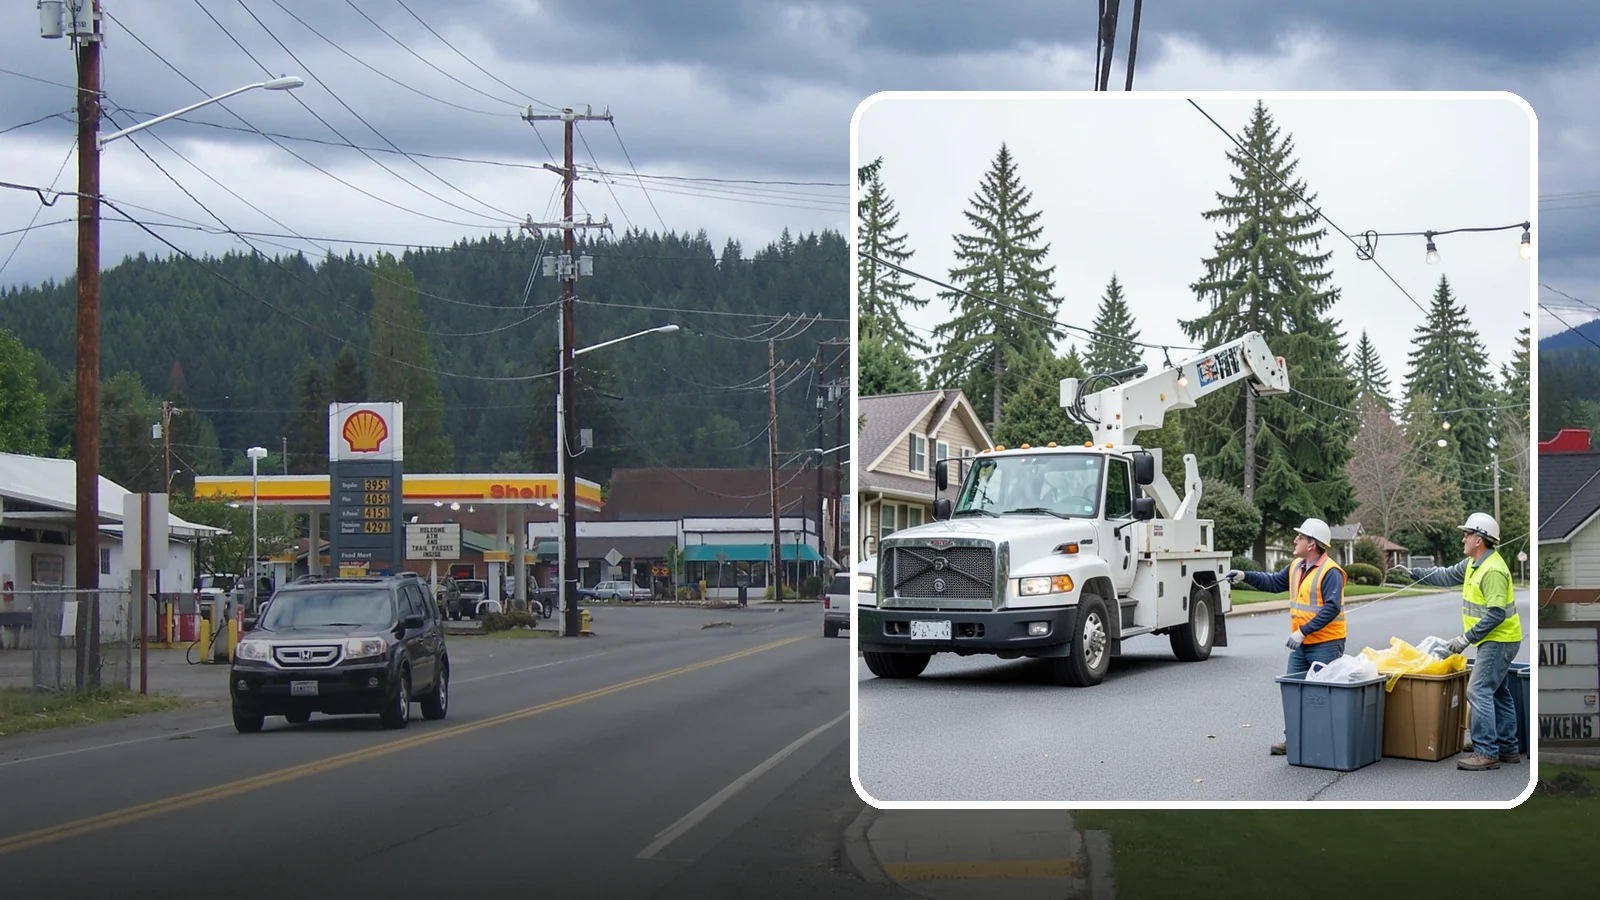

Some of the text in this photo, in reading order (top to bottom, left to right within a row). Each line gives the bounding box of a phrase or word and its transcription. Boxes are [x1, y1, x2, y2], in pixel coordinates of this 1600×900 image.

[365, 480, 384, 490] 395
[490, 484, 547, 499] Shell
[365, 494, 384, 504] 405
[365, 508, 384, 518] 415
[365, 522, 384, 533] 429
